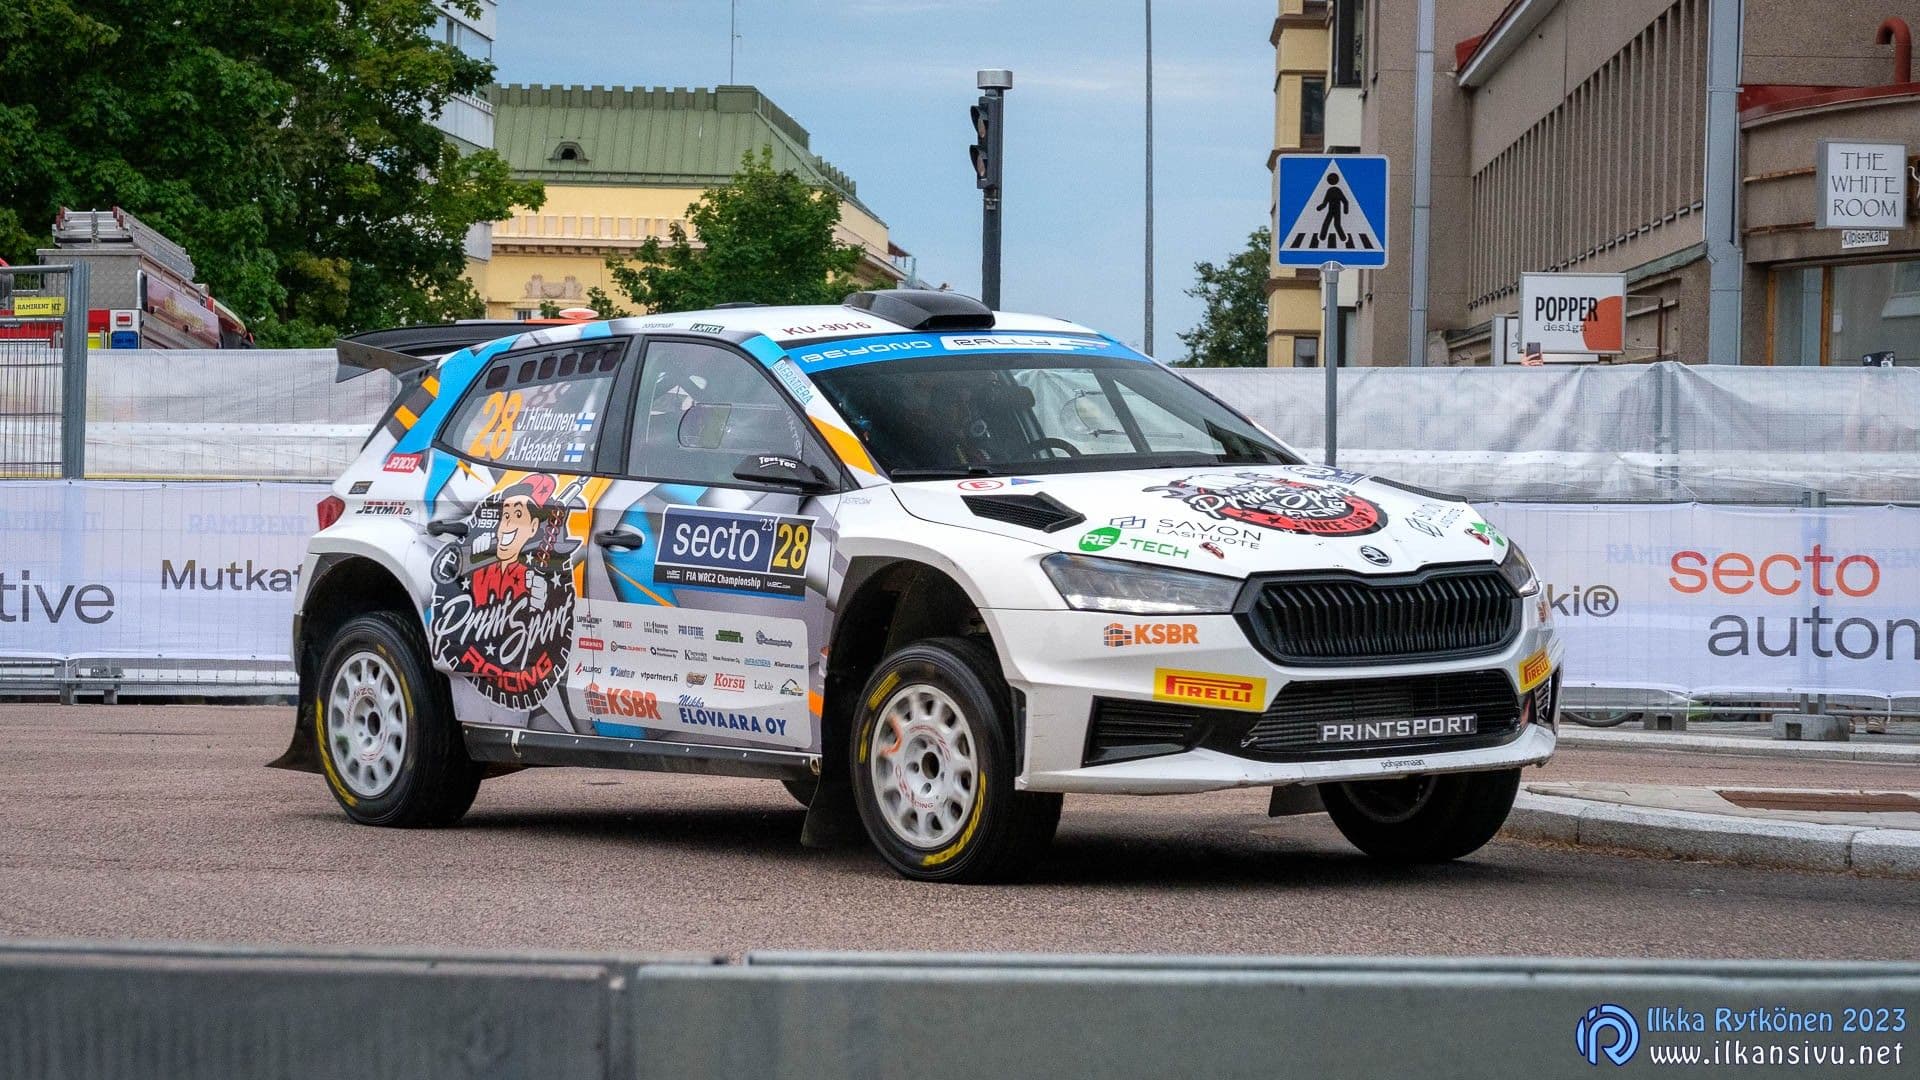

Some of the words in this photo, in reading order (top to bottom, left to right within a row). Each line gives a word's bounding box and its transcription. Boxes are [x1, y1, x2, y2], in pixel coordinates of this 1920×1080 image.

[1840, 152, 1888, 171] THE
[1831, 175, 1900, 194] WHITE
[1833, 198, 1897, 217] ROOM
[1535, 296, 1599, 322] POPPER
[783, 321, 872, 336] KU-9016
[1543, 322, 1588, 333] design
[802, 340, 933, 364] BEYOND
[953, 338, 1052, 346] RALLY
[468, 391, 523, 460] 28
[506, 437, 562, 466] A.Haapala
[355, 501, 405, 514] JERMIX
[481, 509, 499, 519] EST.
[477, 518, 499, 529] 1997
[1158, 518, 1262, 542] SAVON
[672, 520, 760, 562] secto
[772, 523, 809, 570] 28
[1156, 528, 1261, 550] LASITUOTE
[685, 571, 697, 581] FIA
[697, 572, 716, 583] WRC2
[717, 574, 761, 589] Championship
[1669, 544, 1881, 598] secto
[434, 593, 573, 671] PrintSport
[1134, 624, 1199, 644] KSBR
[461, 646, 553, 692] RACING
[640, 672, 678, 682] vtpartners.fi
[1524, 651, 1549, 685] PIRELLI
[714, 672, 745, 690] Korsu
[1166, 675, 1253, 703] PIRELLI
[607, 687, 662, 720] KSBR
[679, 708, 762, 733] ELOVAARA
[765, 718, 787, 736] OY
[1322, 715, 1475, 742] PRINTSPORT
